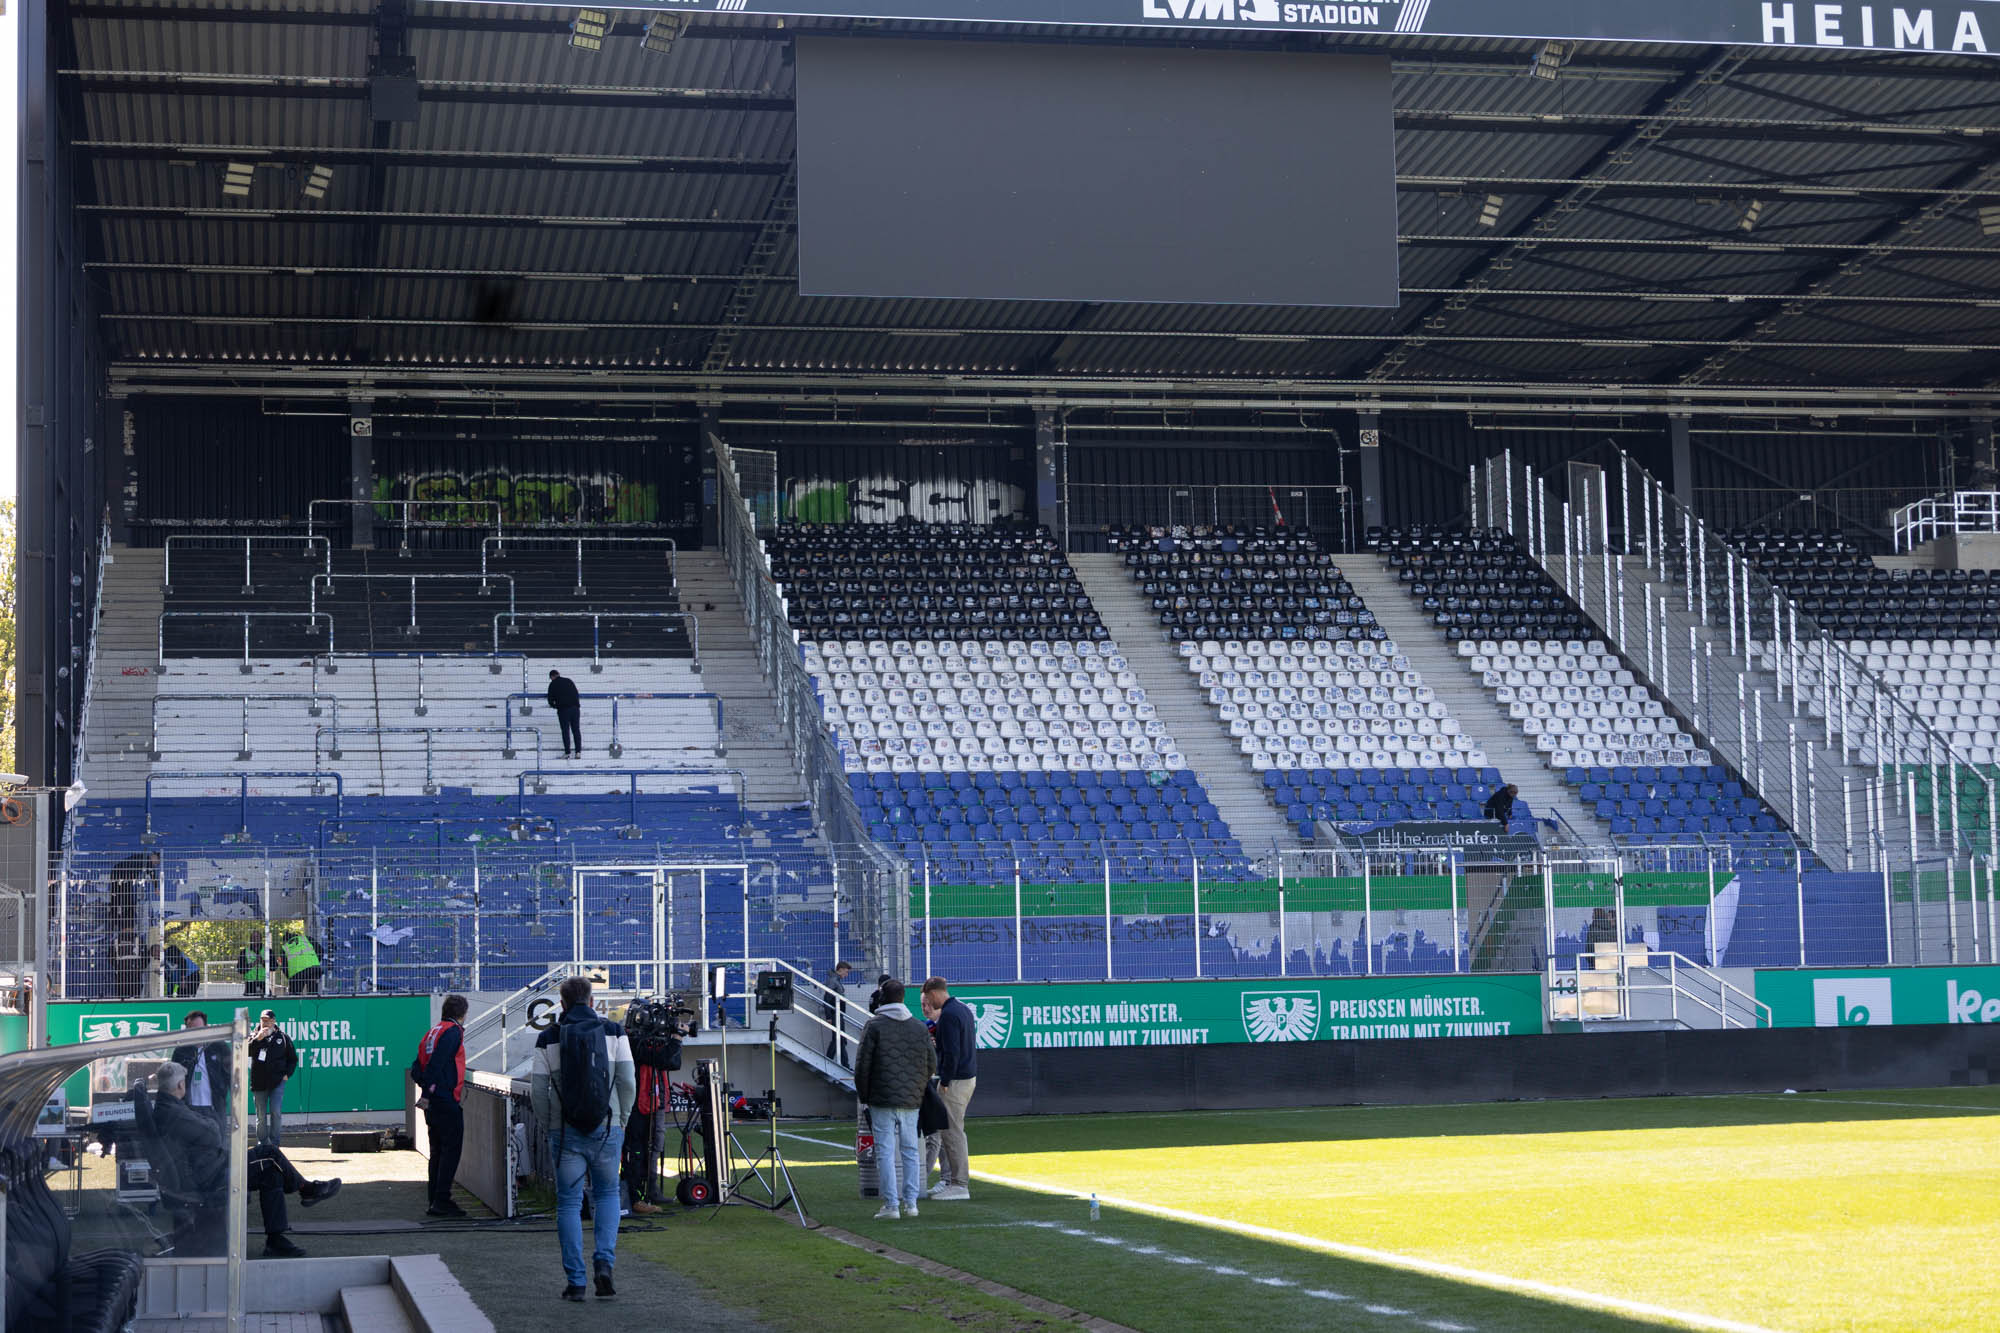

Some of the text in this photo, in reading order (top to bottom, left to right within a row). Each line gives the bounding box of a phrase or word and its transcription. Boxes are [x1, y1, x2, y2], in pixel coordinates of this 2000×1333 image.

[1283, 4, 1379, 25] STADION
[1761, 2, 1988, 52] HEIMA
[1555, 978, 1578, 995] 13
[1022, 1000, 1183, 1026] PREUSSEN MÜNSTER.
[1329, 994, 1485, 1020] PREUSSEN MÜNSTER.
[1023, 1030, 1104, 1049] TRADITION
[1108, 1029, 1138, 1047] MIT
[1331, 1023, 1411, 1041] TRADITION
[1415, 1022, 1442, 1039] MIT
[310, 1045, 390, 1068] ZUKUNFT.
